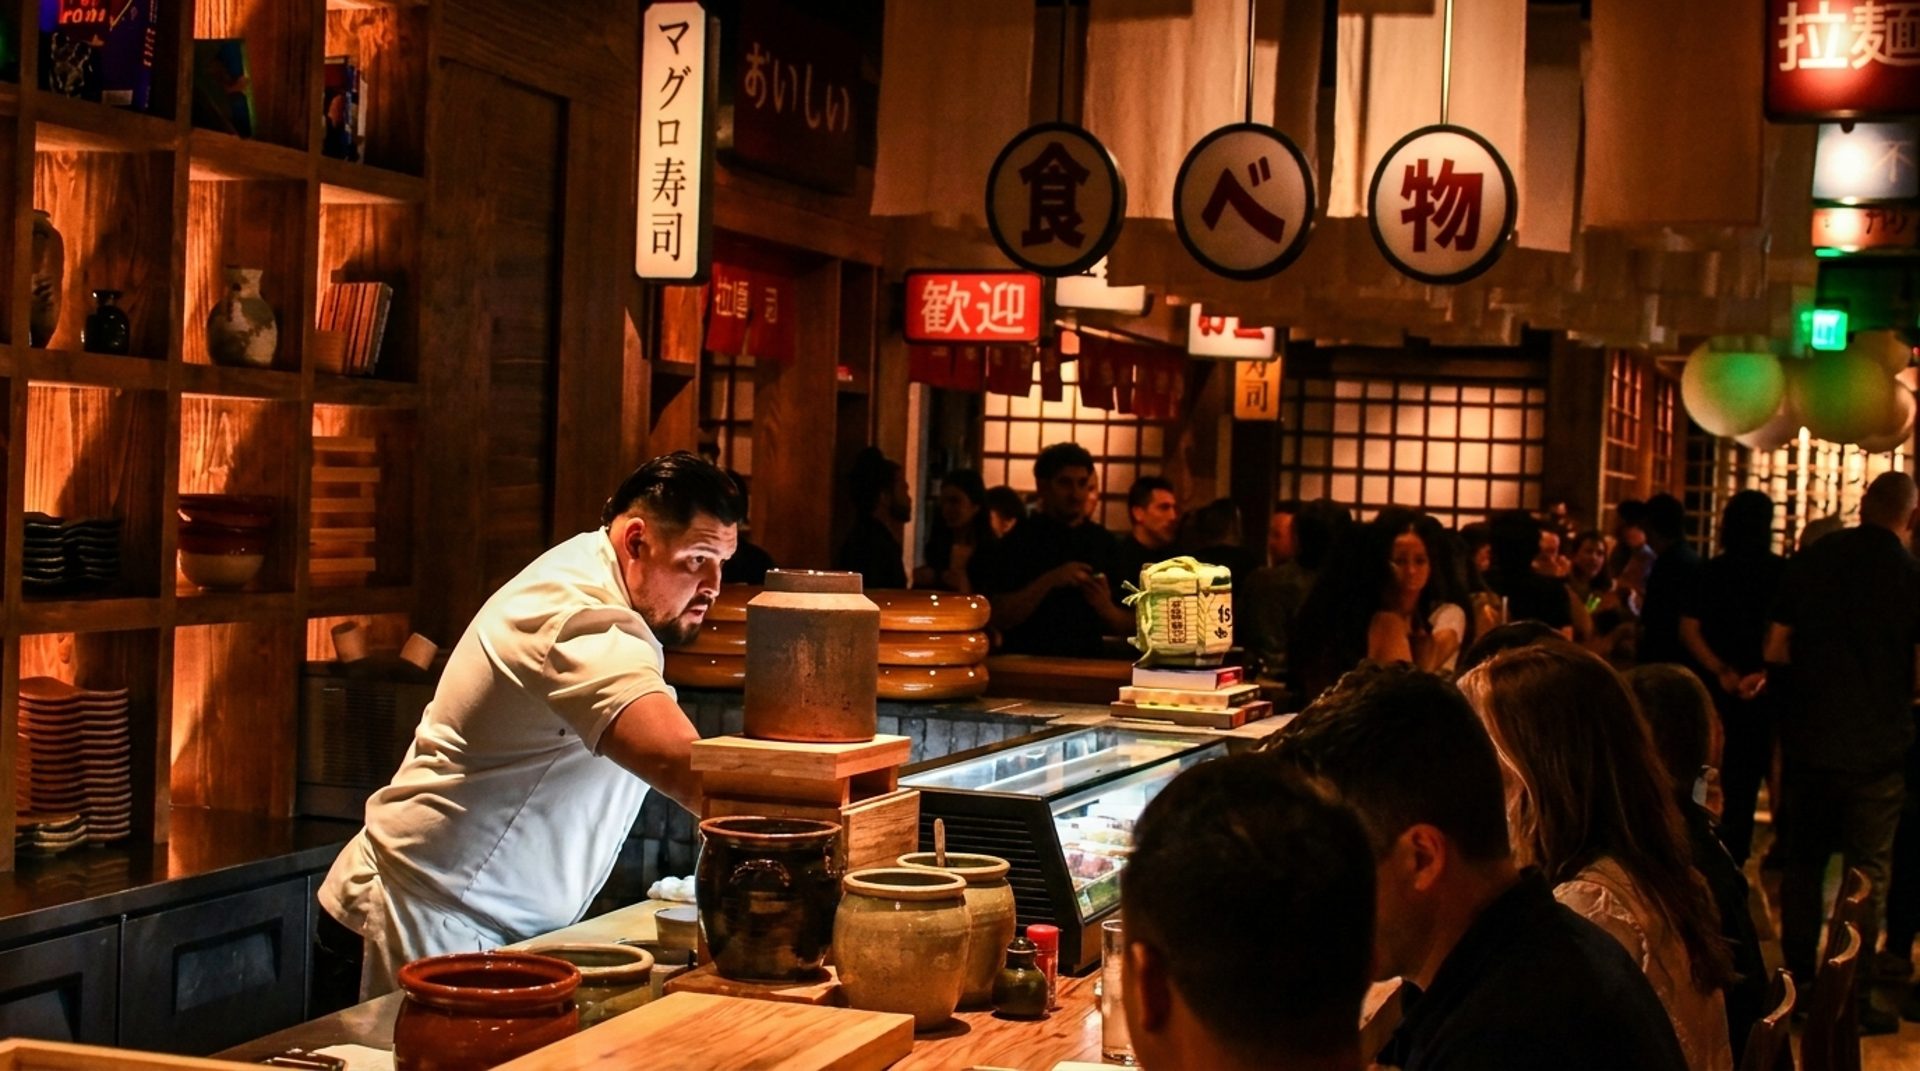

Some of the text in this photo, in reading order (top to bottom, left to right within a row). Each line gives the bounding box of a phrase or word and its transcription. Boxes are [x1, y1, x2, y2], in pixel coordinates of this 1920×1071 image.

[744, 40, 851, 132] おいしい
[652, 20, 692, 262] マグロ寿司
[921, 279, 1026, 335] 歓迎
